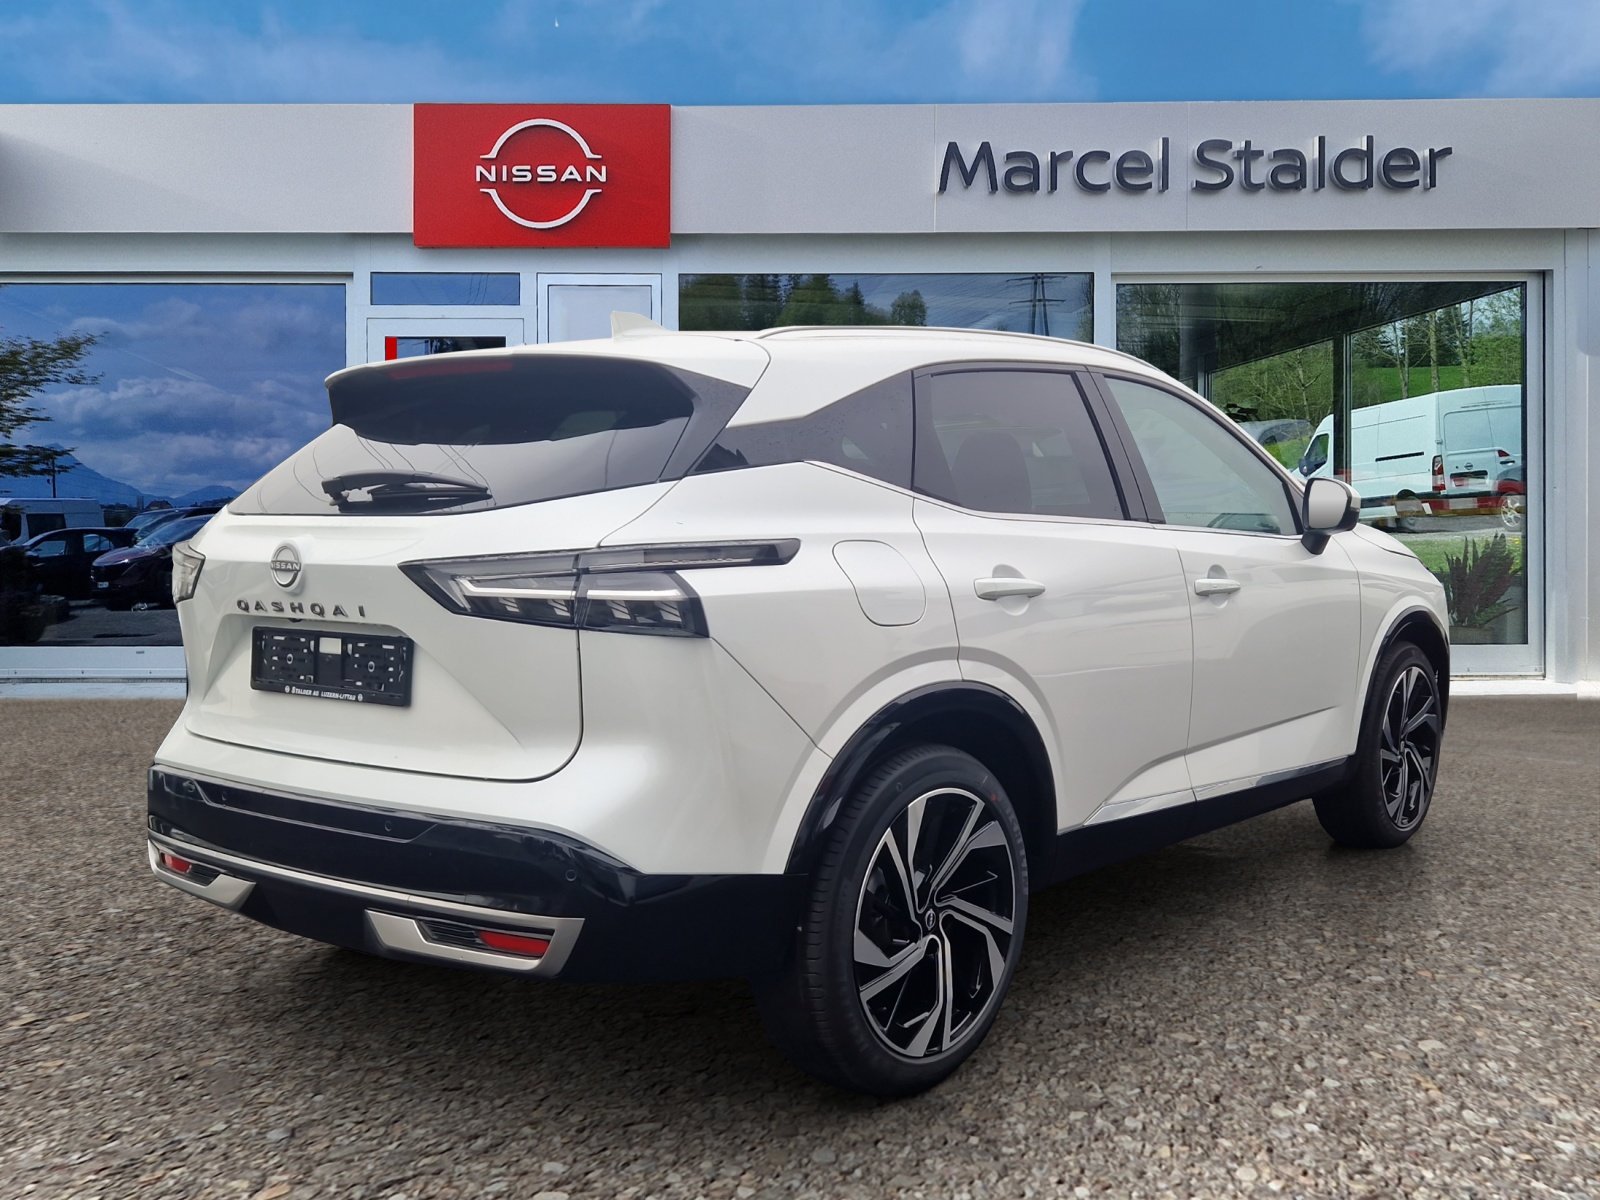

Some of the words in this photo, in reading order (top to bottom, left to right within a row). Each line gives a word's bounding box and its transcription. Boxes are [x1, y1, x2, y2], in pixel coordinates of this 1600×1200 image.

[938, 137, 1170, 194] Marcel
[1192, 135, 1452, 192] Stalder
[475, 165, 607, 183] NISSAN
[271, 561, 300, 571] NISSAN
[237, 599, 366, 618] QASHQAI
